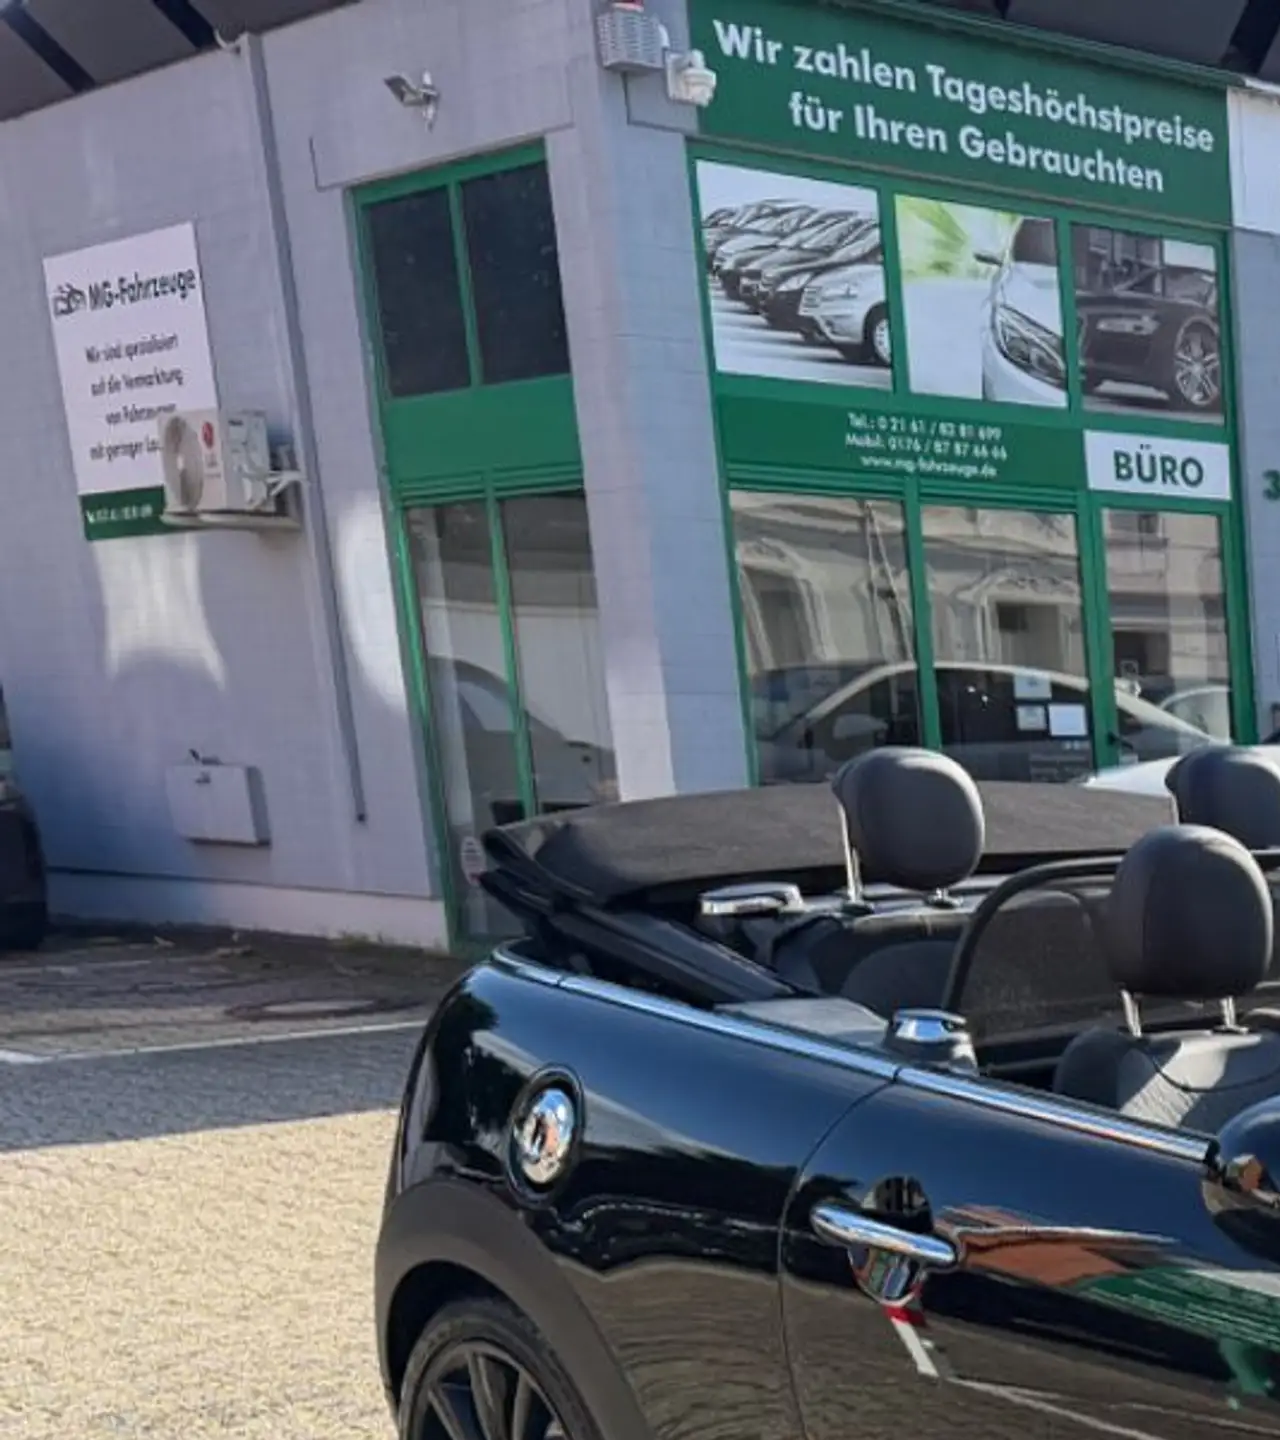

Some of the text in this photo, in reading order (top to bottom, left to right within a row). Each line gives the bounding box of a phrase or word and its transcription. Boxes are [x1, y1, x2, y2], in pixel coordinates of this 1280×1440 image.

[712, 20, 1215, 152] Wir zahlen Tageshöchstpreise
[789, 92, 1165, 193] für Ihren Gebrauchten
[87, 268, 196, 311] MG-Fahrzeuge
[1114, 444, 1204, 488] BÜRO
